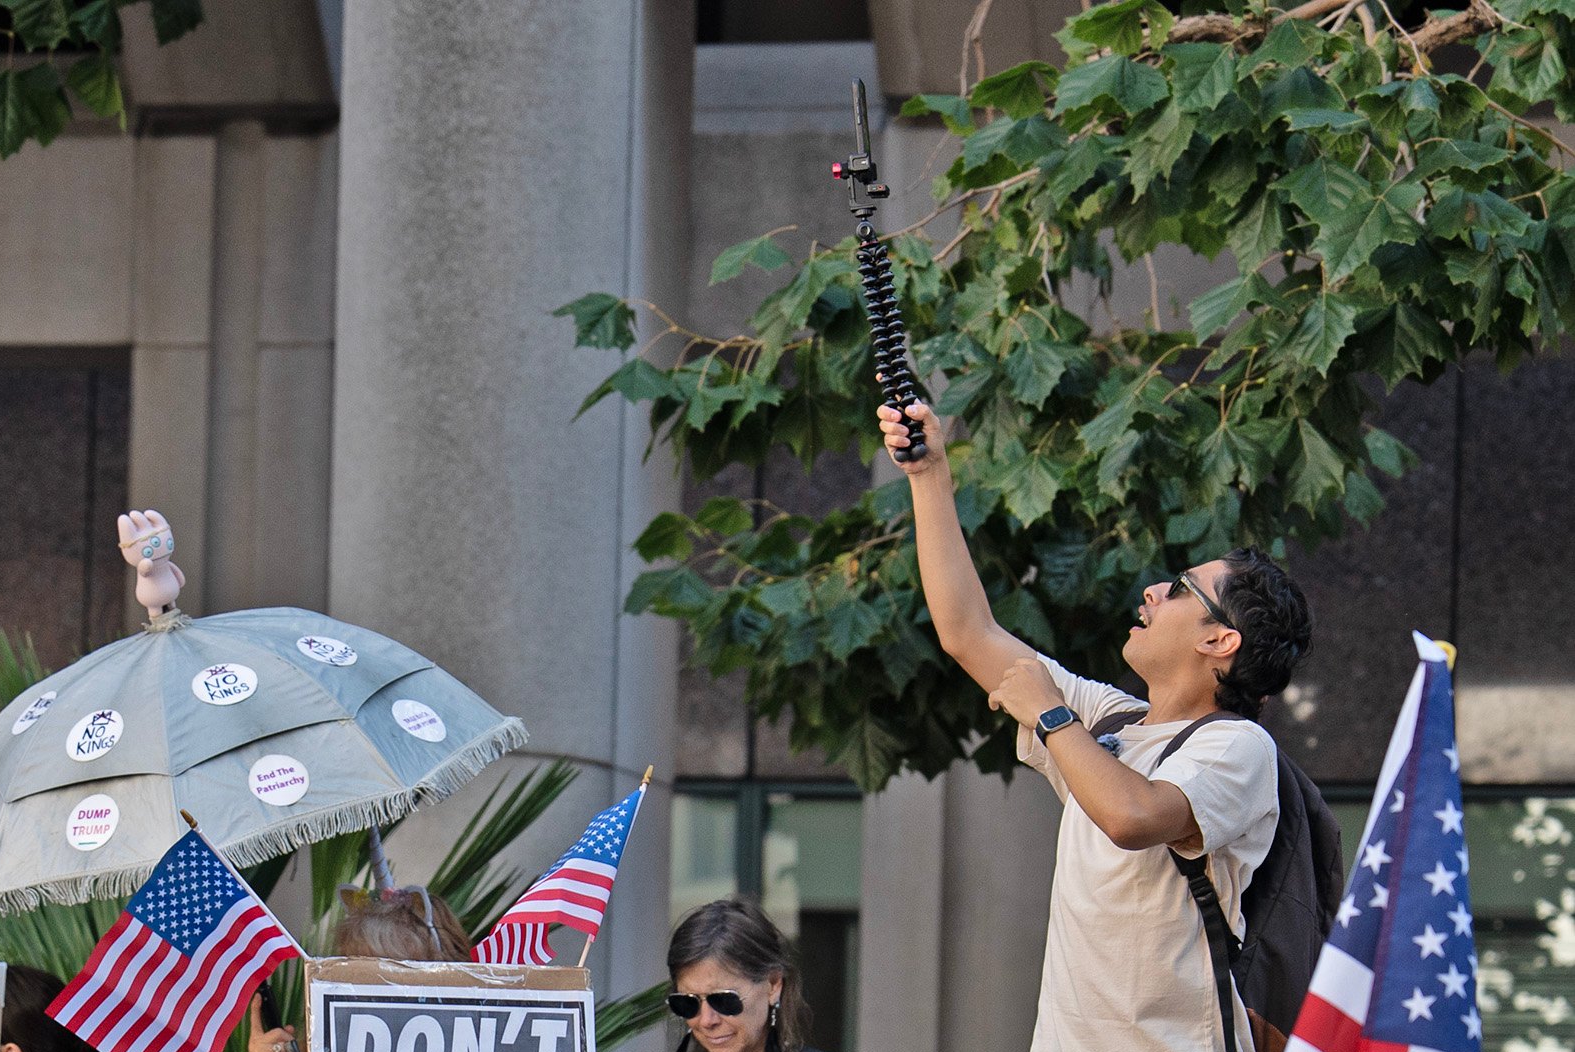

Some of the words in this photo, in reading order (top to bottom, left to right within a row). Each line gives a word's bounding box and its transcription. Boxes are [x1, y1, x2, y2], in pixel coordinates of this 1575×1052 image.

[204, 674, 238, 692] NO
[208, 683, 250, 701] KINGS
[82, 725, 106, 740] NO
[76, 735, 115, 756] KINGS
[257, 770, 276, 783] End
[276, 765, 295, 777] The
[256, 774, 306, 795] Patriarchy
[78, 808, 111, 820] DUMP
[72, 824, 111, 837] TRUMP
